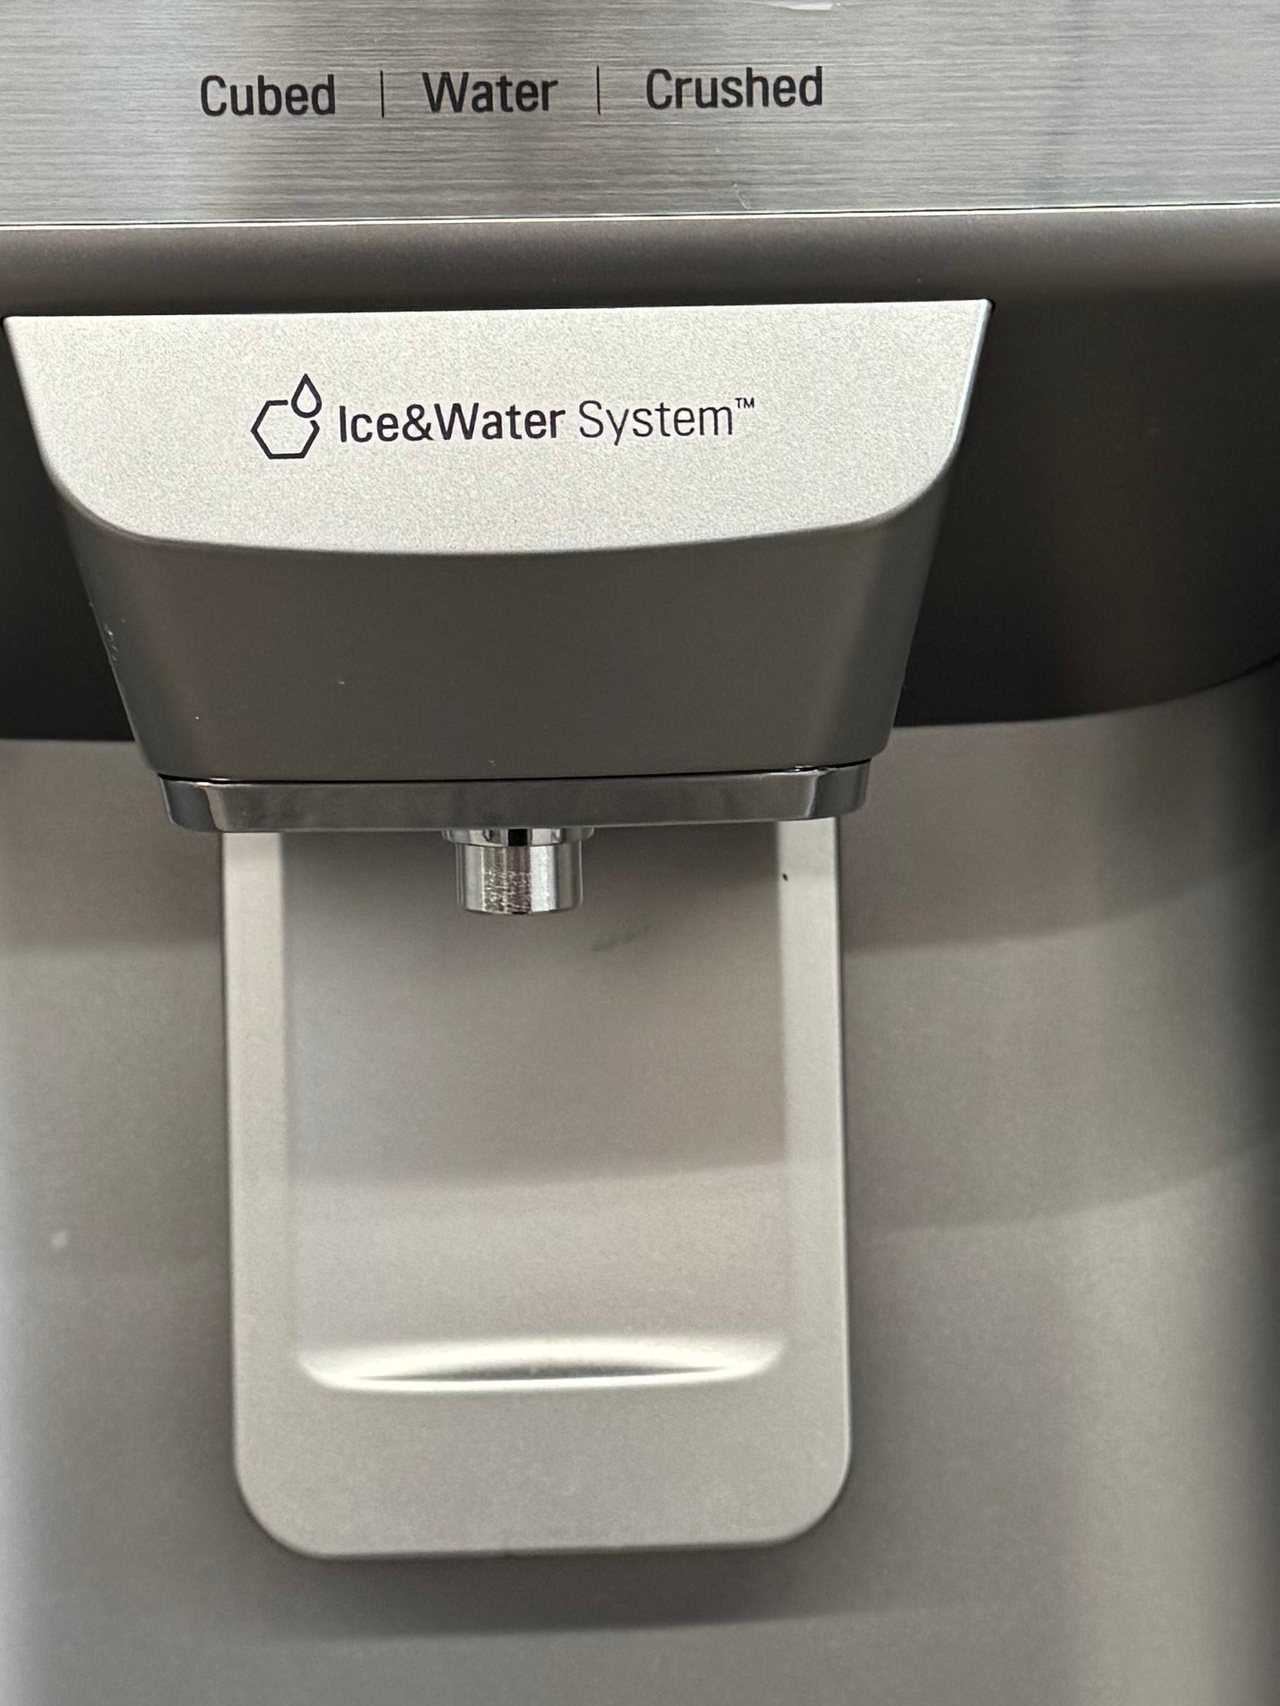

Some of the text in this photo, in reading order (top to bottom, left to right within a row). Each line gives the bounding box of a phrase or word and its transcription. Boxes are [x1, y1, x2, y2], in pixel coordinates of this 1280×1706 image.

[200, 73, 336, 118] Cubed
[421, 71, 559, 114] Water
[645, 65, 823, 110] Crushed
[338, 401, 567, 444] Ice&Water
